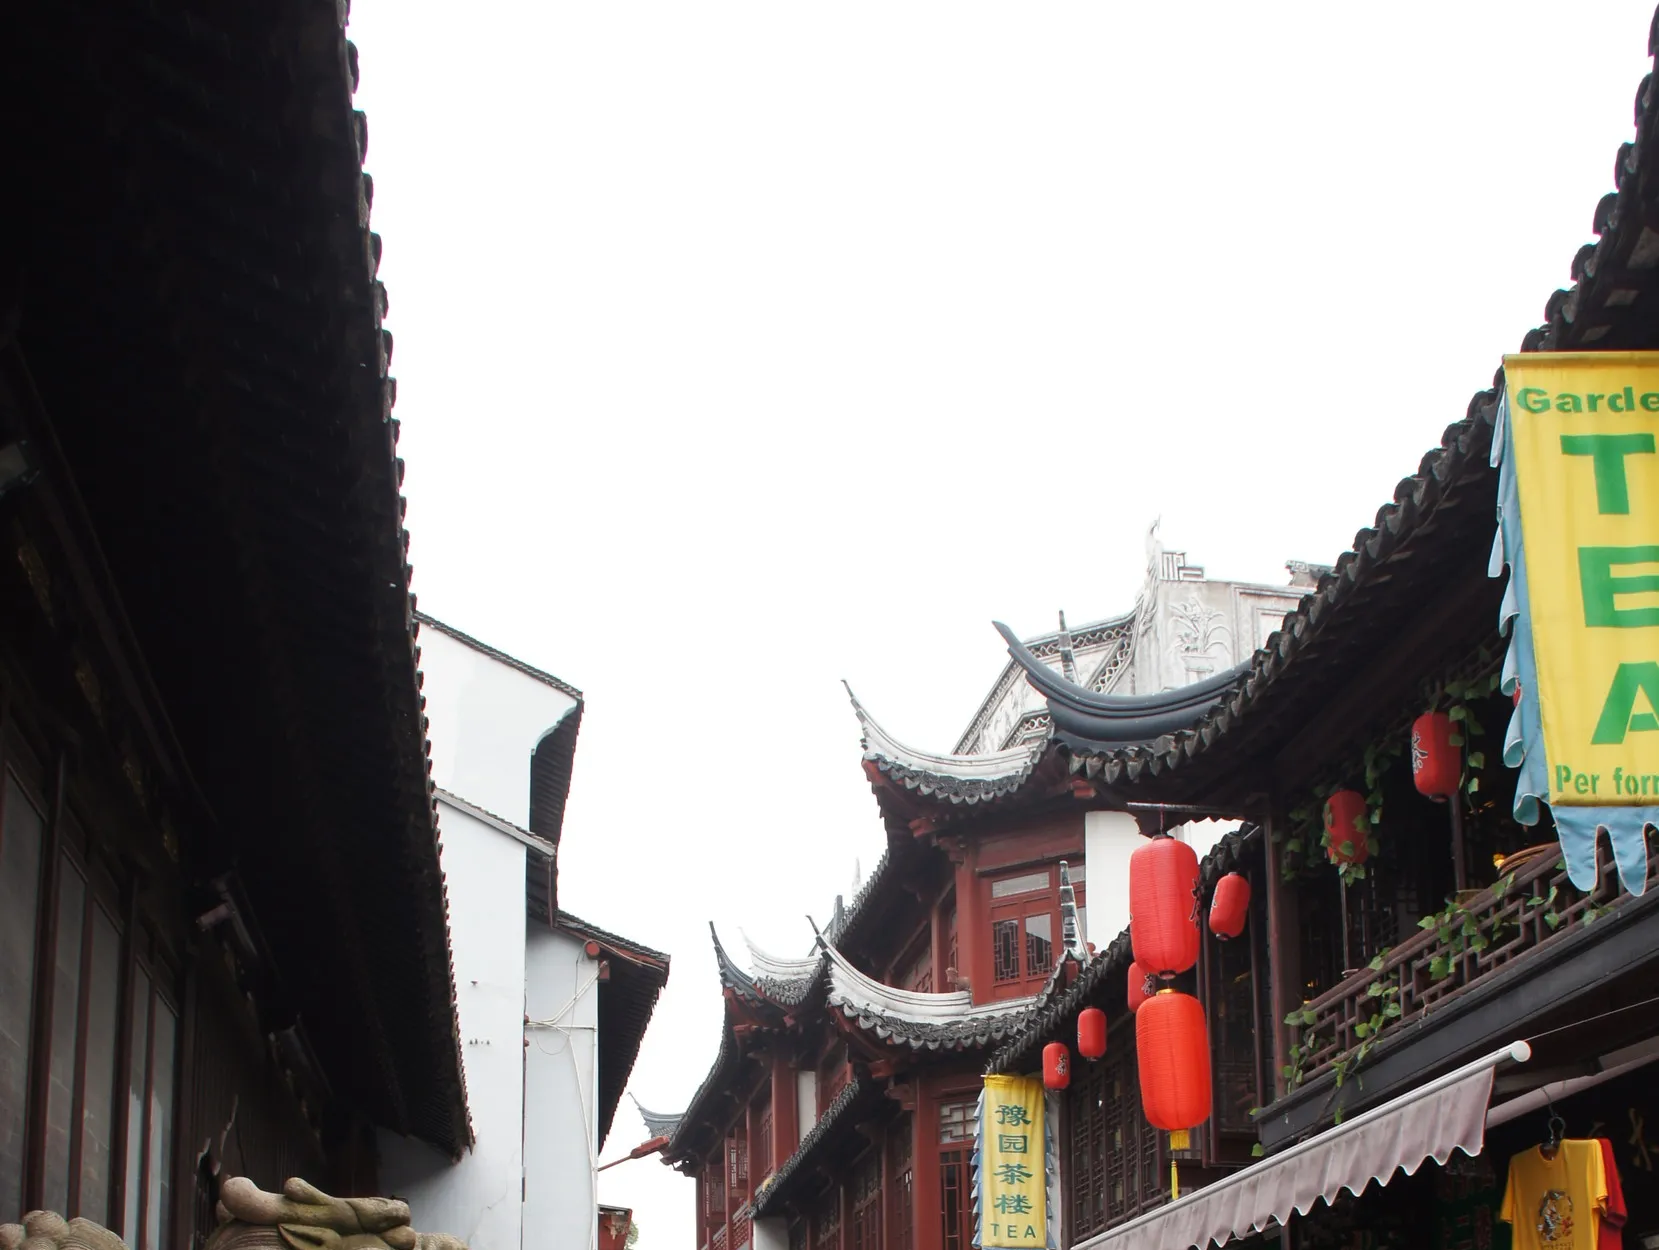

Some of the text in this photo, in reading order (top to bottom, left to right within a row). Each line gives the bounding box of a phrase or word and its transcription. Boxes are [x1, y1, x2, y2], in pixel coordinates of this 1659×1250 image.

[1555, 764, 1600, 794] Per
[993, 1103, 1033, 1215] 豫园茶楼
[990, 1223, 1036, 1239] TEA
